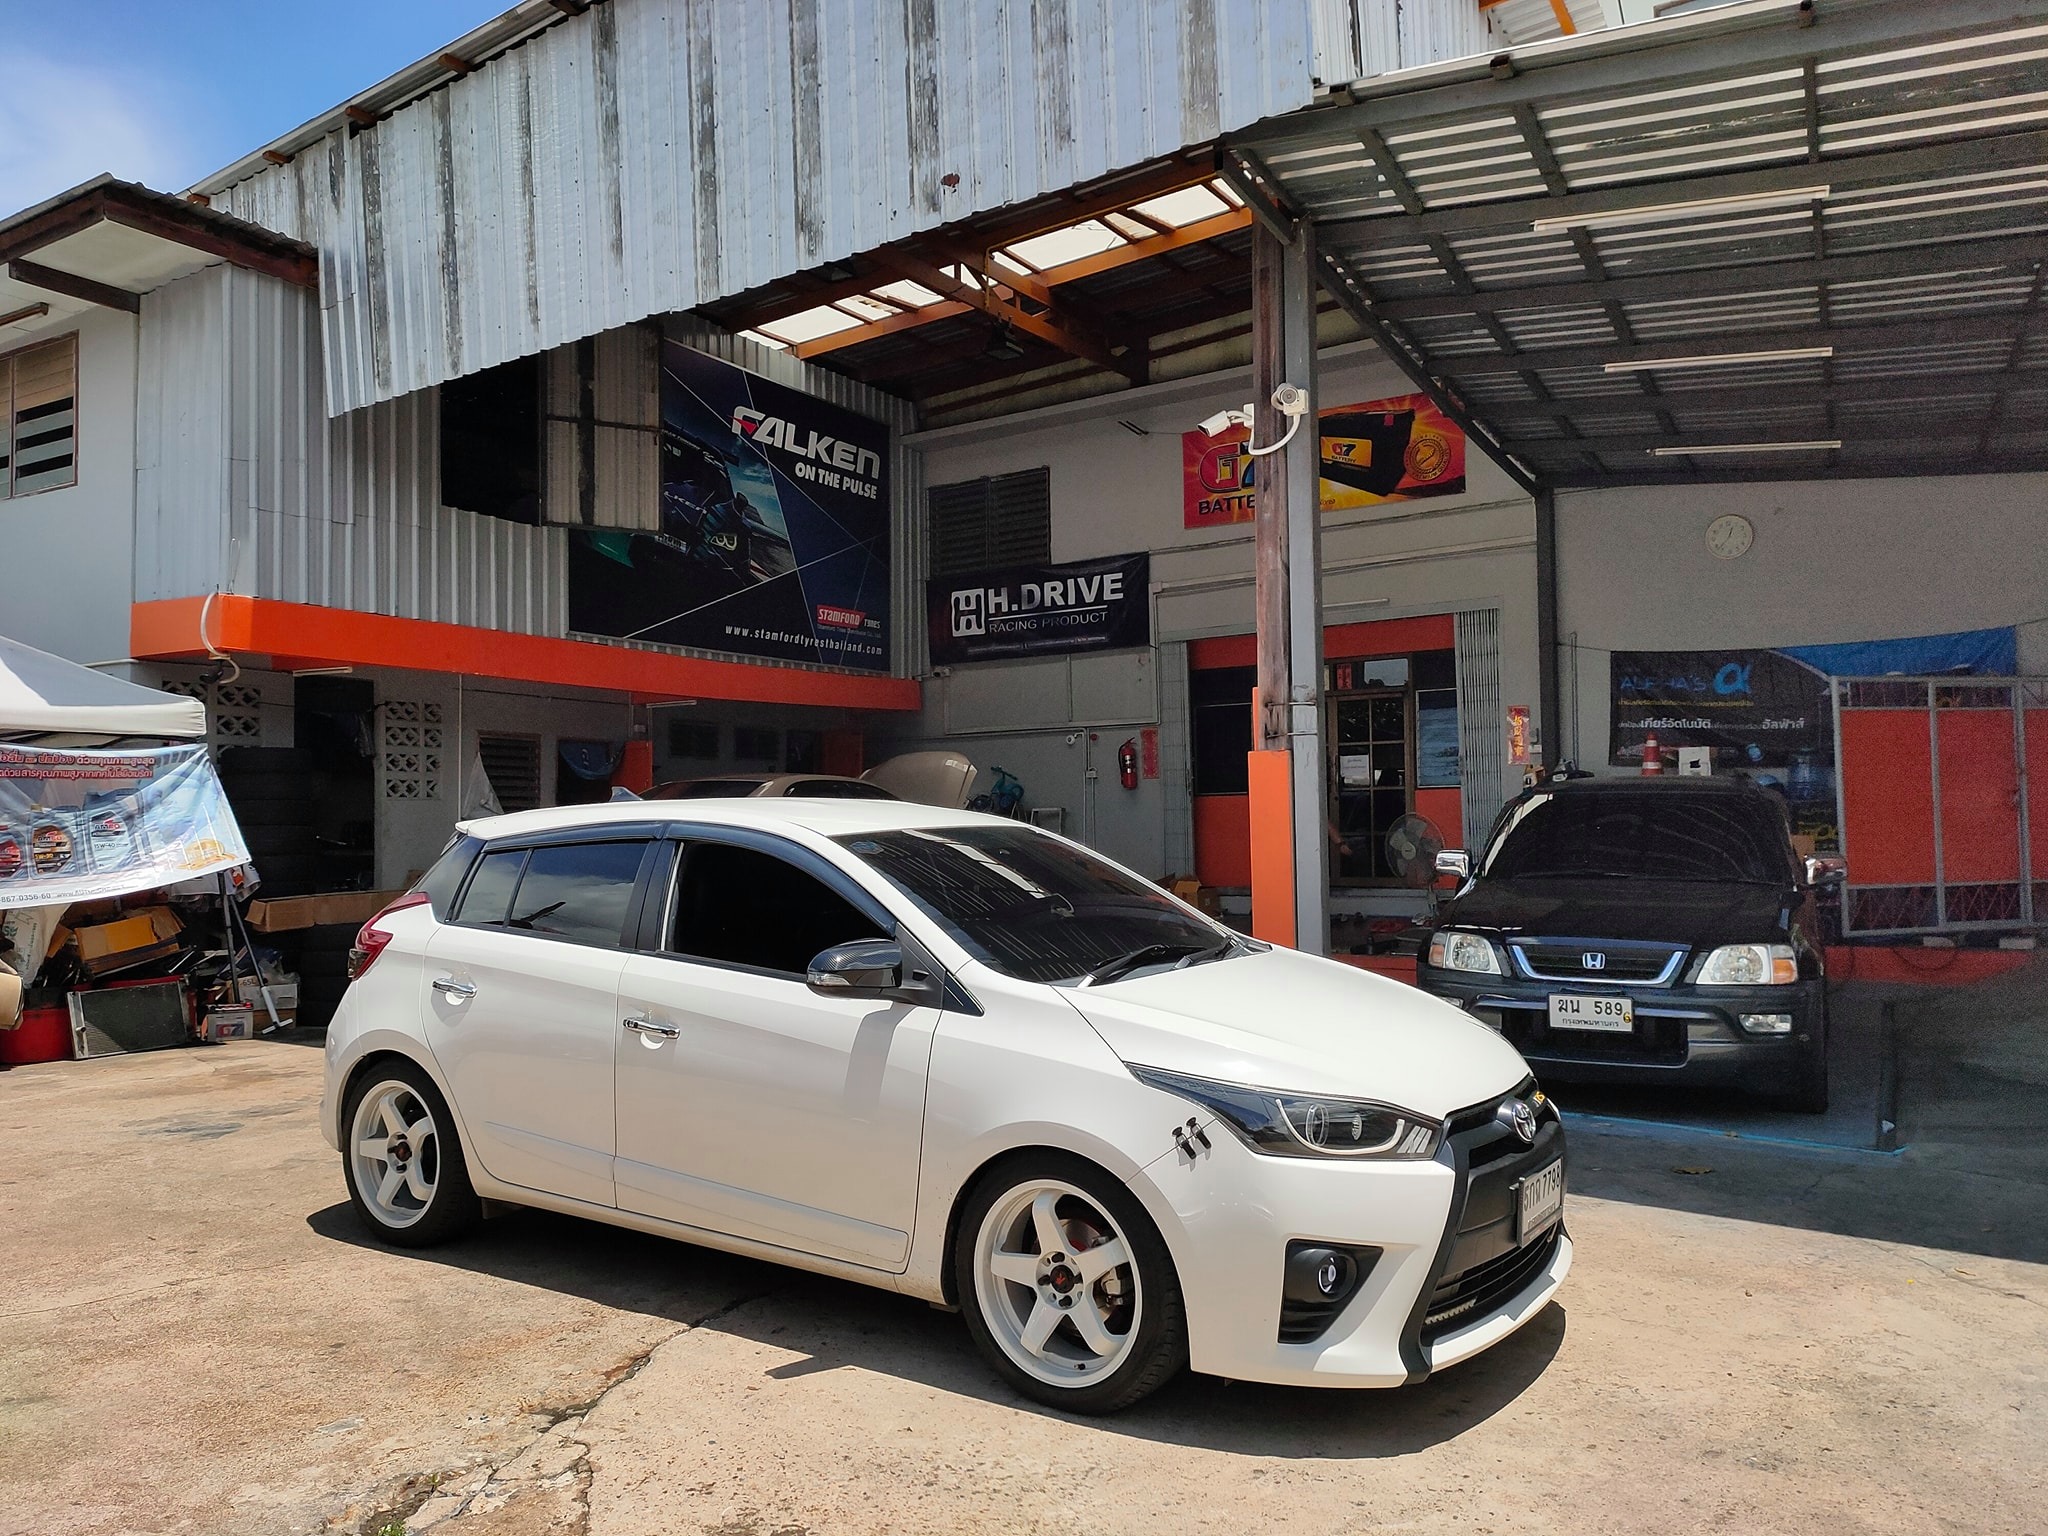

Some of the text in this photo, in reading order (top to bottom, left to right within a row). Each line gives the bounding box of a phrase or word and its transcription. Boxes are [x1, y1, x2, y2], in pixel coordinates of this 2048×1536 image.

[730, 405, 881, 480] FALKEN
[794, 461, 878, 500] ON THE PULSE
[1198, 493, 1255, 515] BATTE
[988, 572, 1124, 614] H.DRIVE
[989, 611, 1108, 634] RACING PRODUCT
[725, 625, 882, 655] www.stamfordtyresthailand.com
[1594, 1000, 1623, 1016] 589
[1542, 1164, 1562, 1200] 7798
